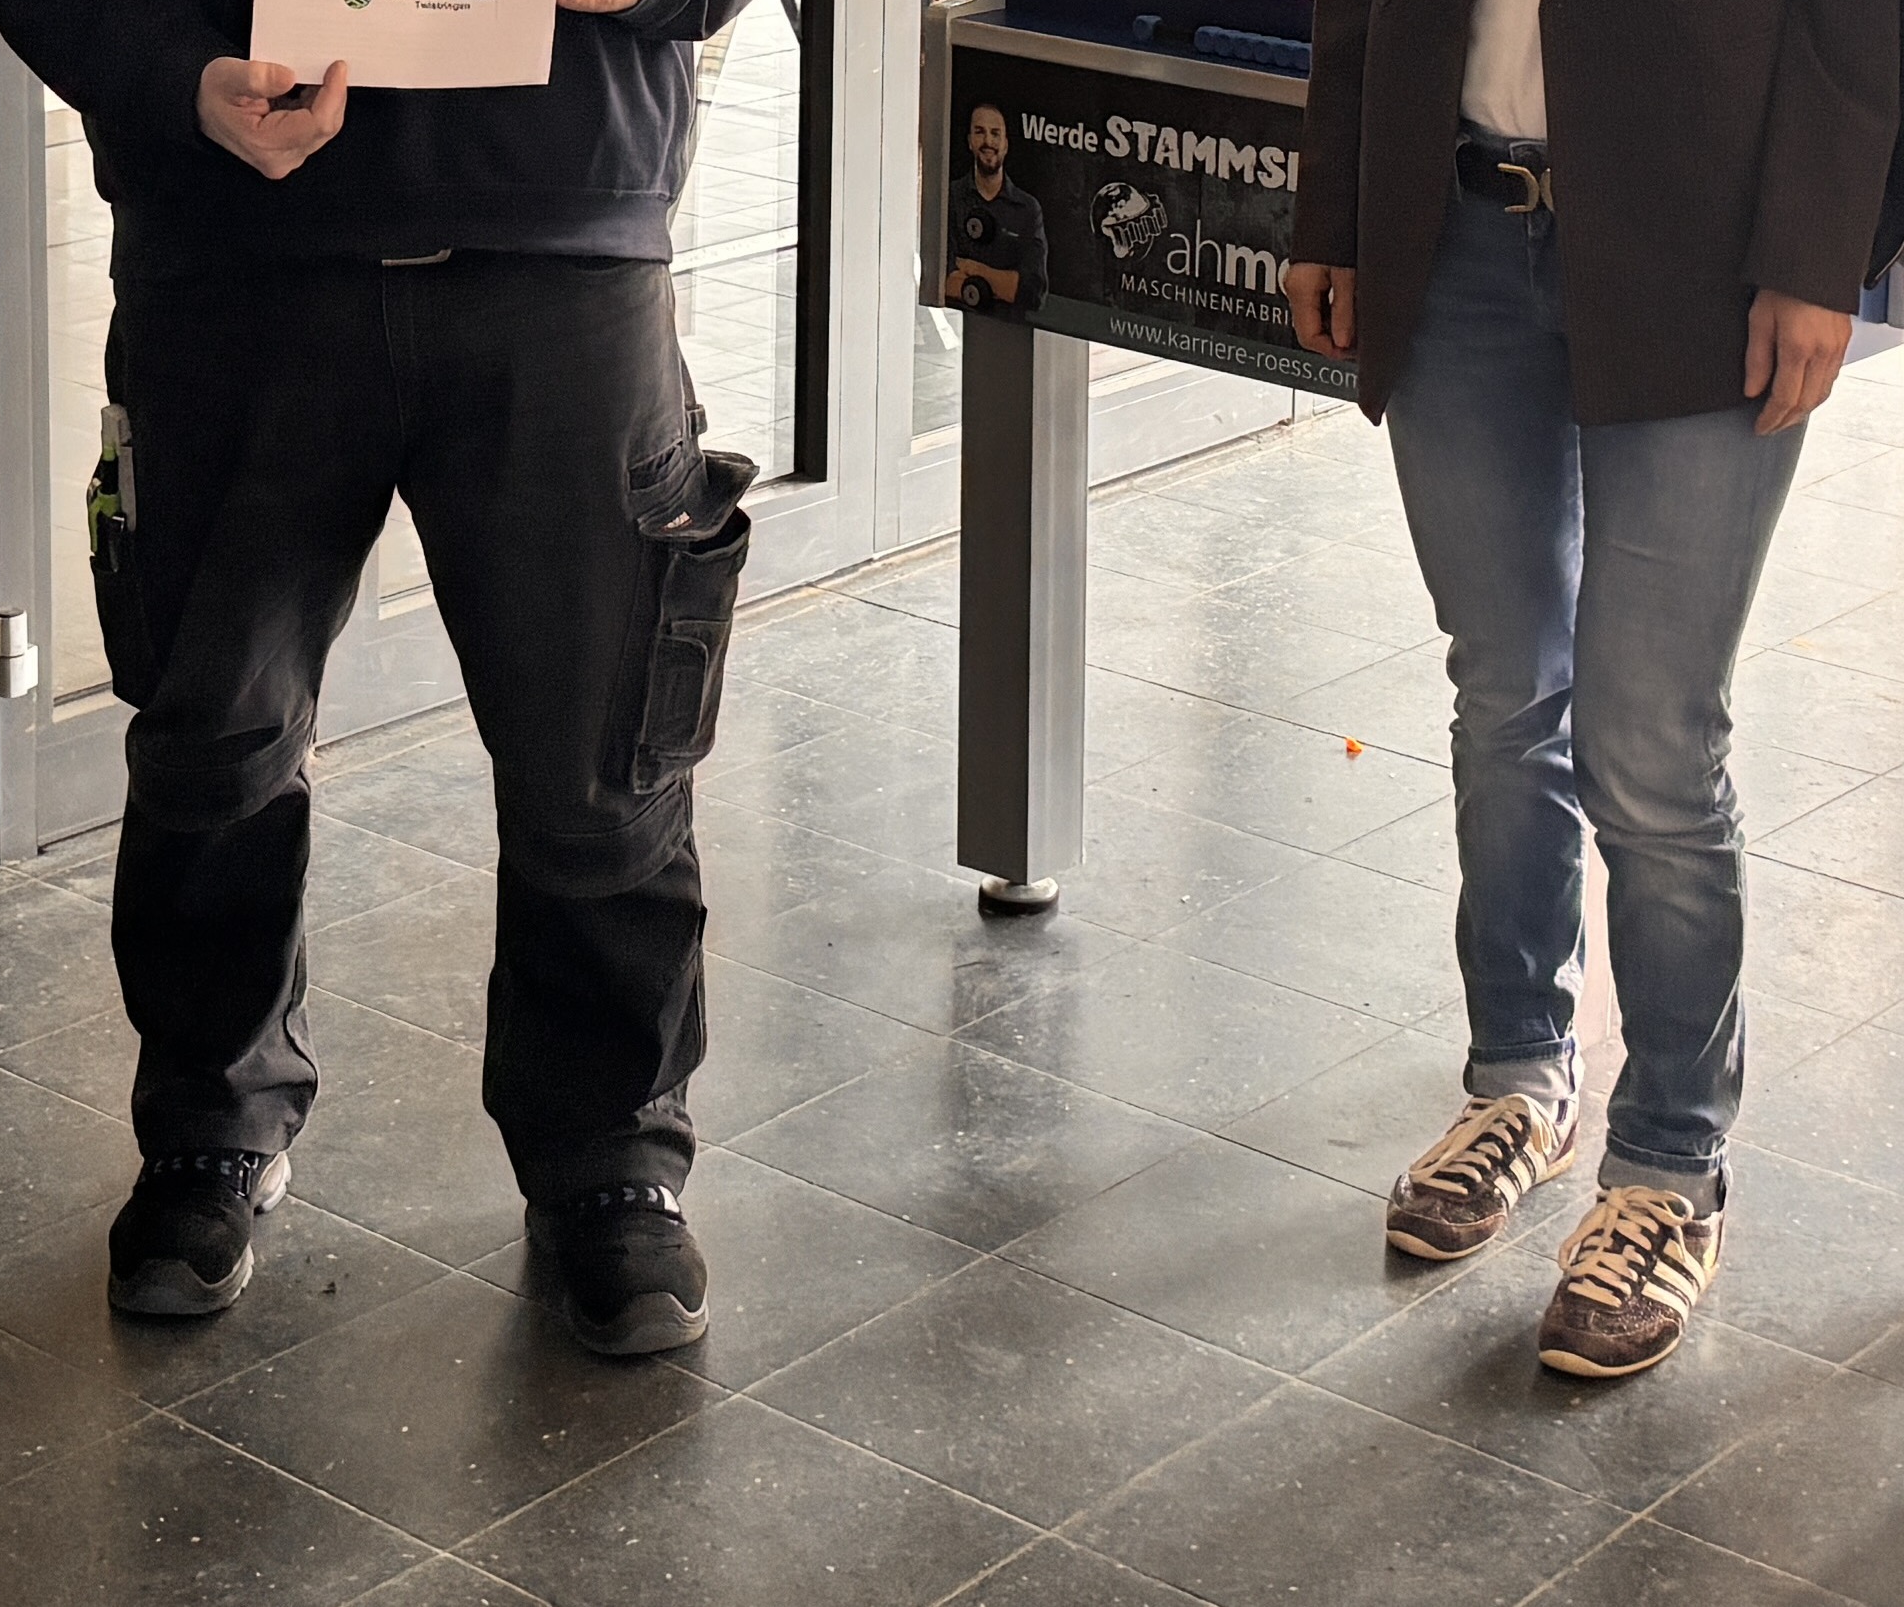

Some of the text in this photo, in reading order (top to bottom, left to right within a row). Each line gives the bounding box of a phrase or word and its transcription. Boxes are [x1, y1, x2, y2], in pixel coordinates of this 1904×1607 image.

[1021, 113, 1099, 153] Werde
[1167, 219, 1290, 297] ahm
[1121, 273, 1295, 328] MASCHINENFABRI
